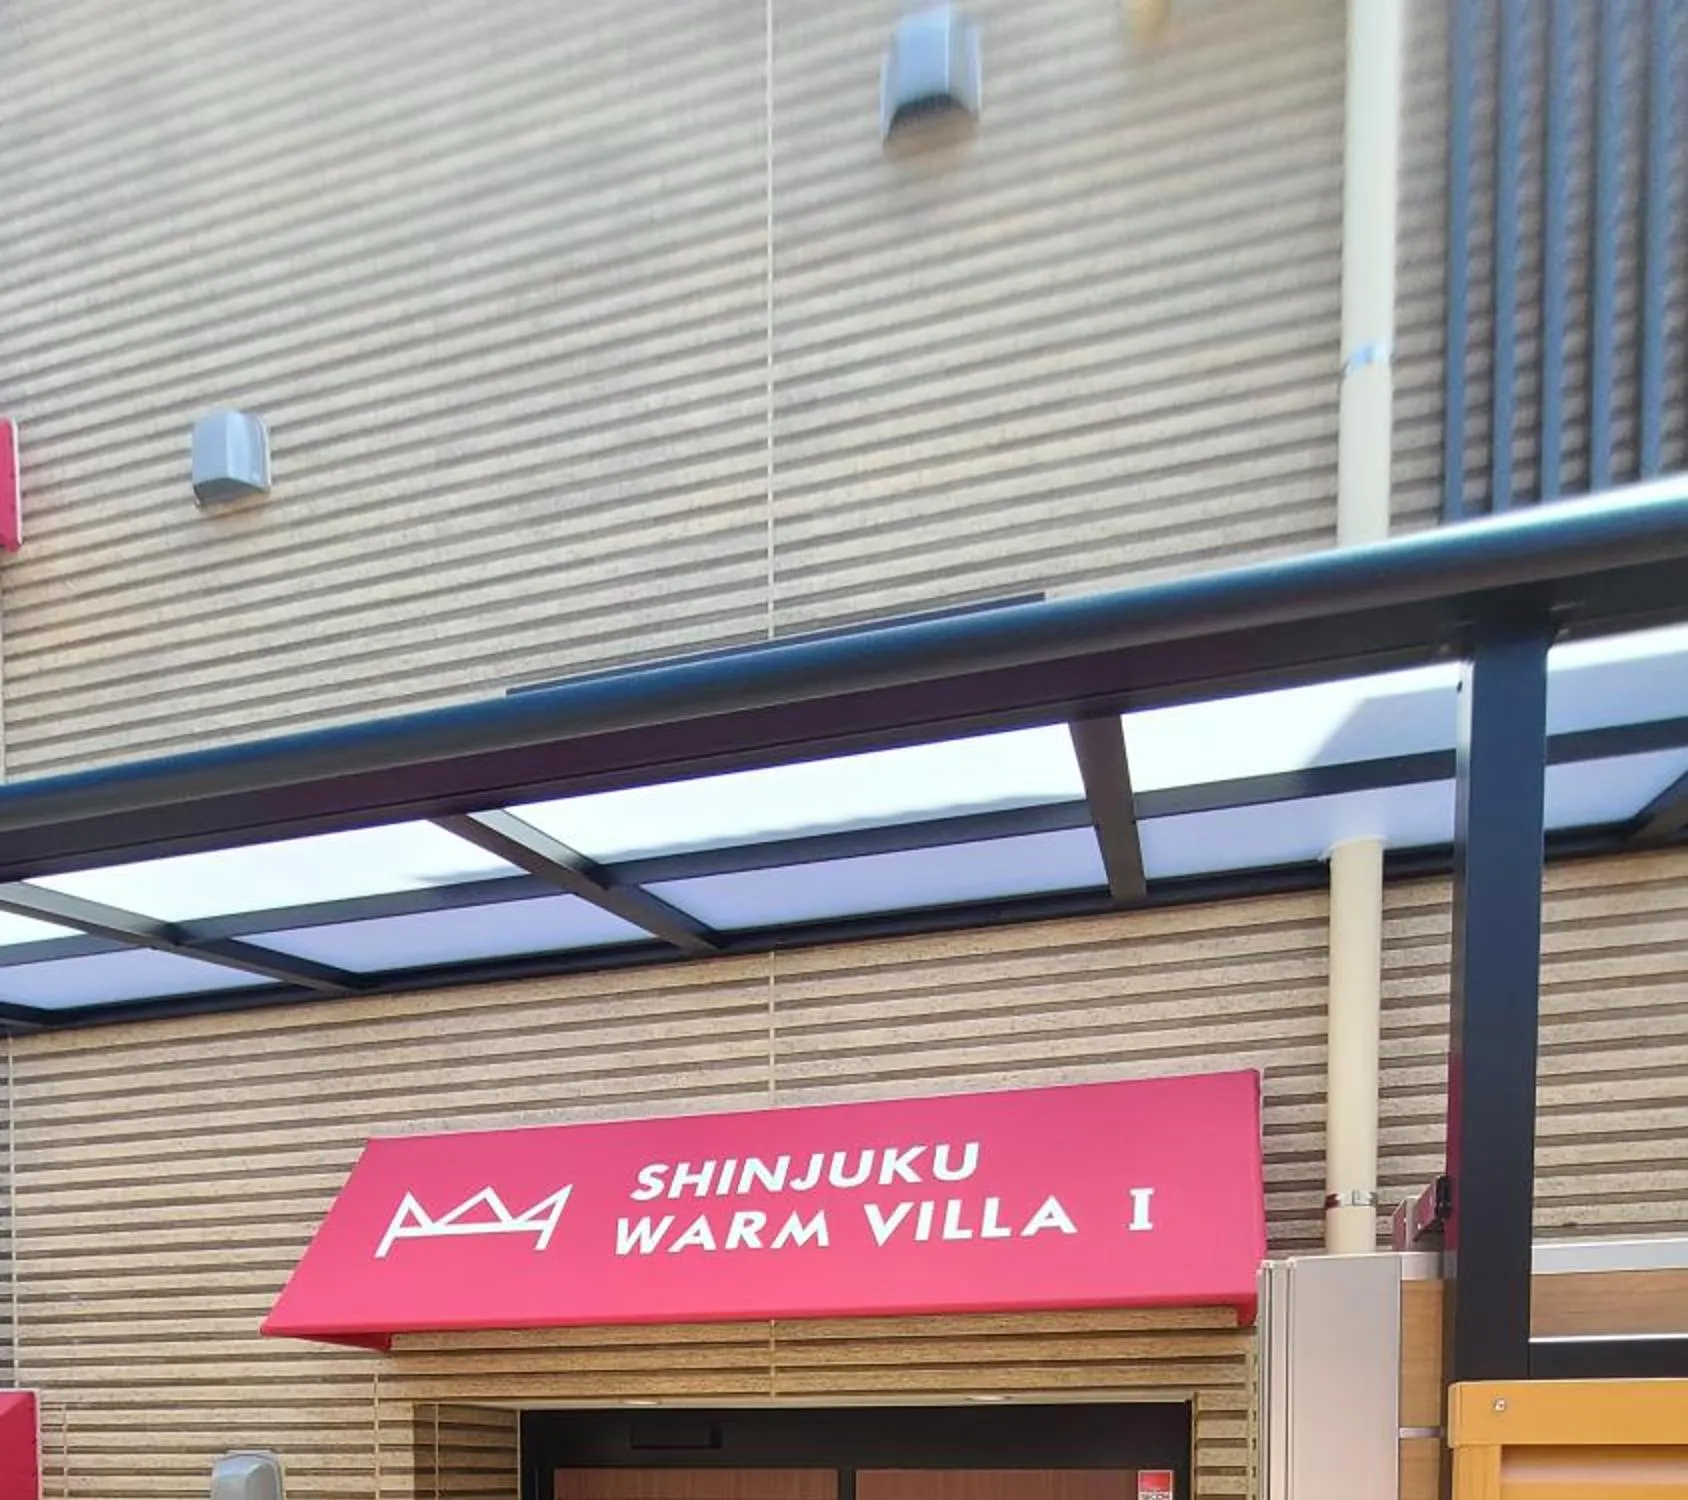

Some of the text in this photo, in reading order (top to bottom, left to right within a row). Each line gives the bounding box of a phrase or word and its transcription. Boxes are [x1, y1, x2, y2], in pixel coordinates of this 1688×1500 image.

[630, 1141, 980, 1201] SHINJUKU
[614, 1187, 1155, 1256] WARM VILLA I
